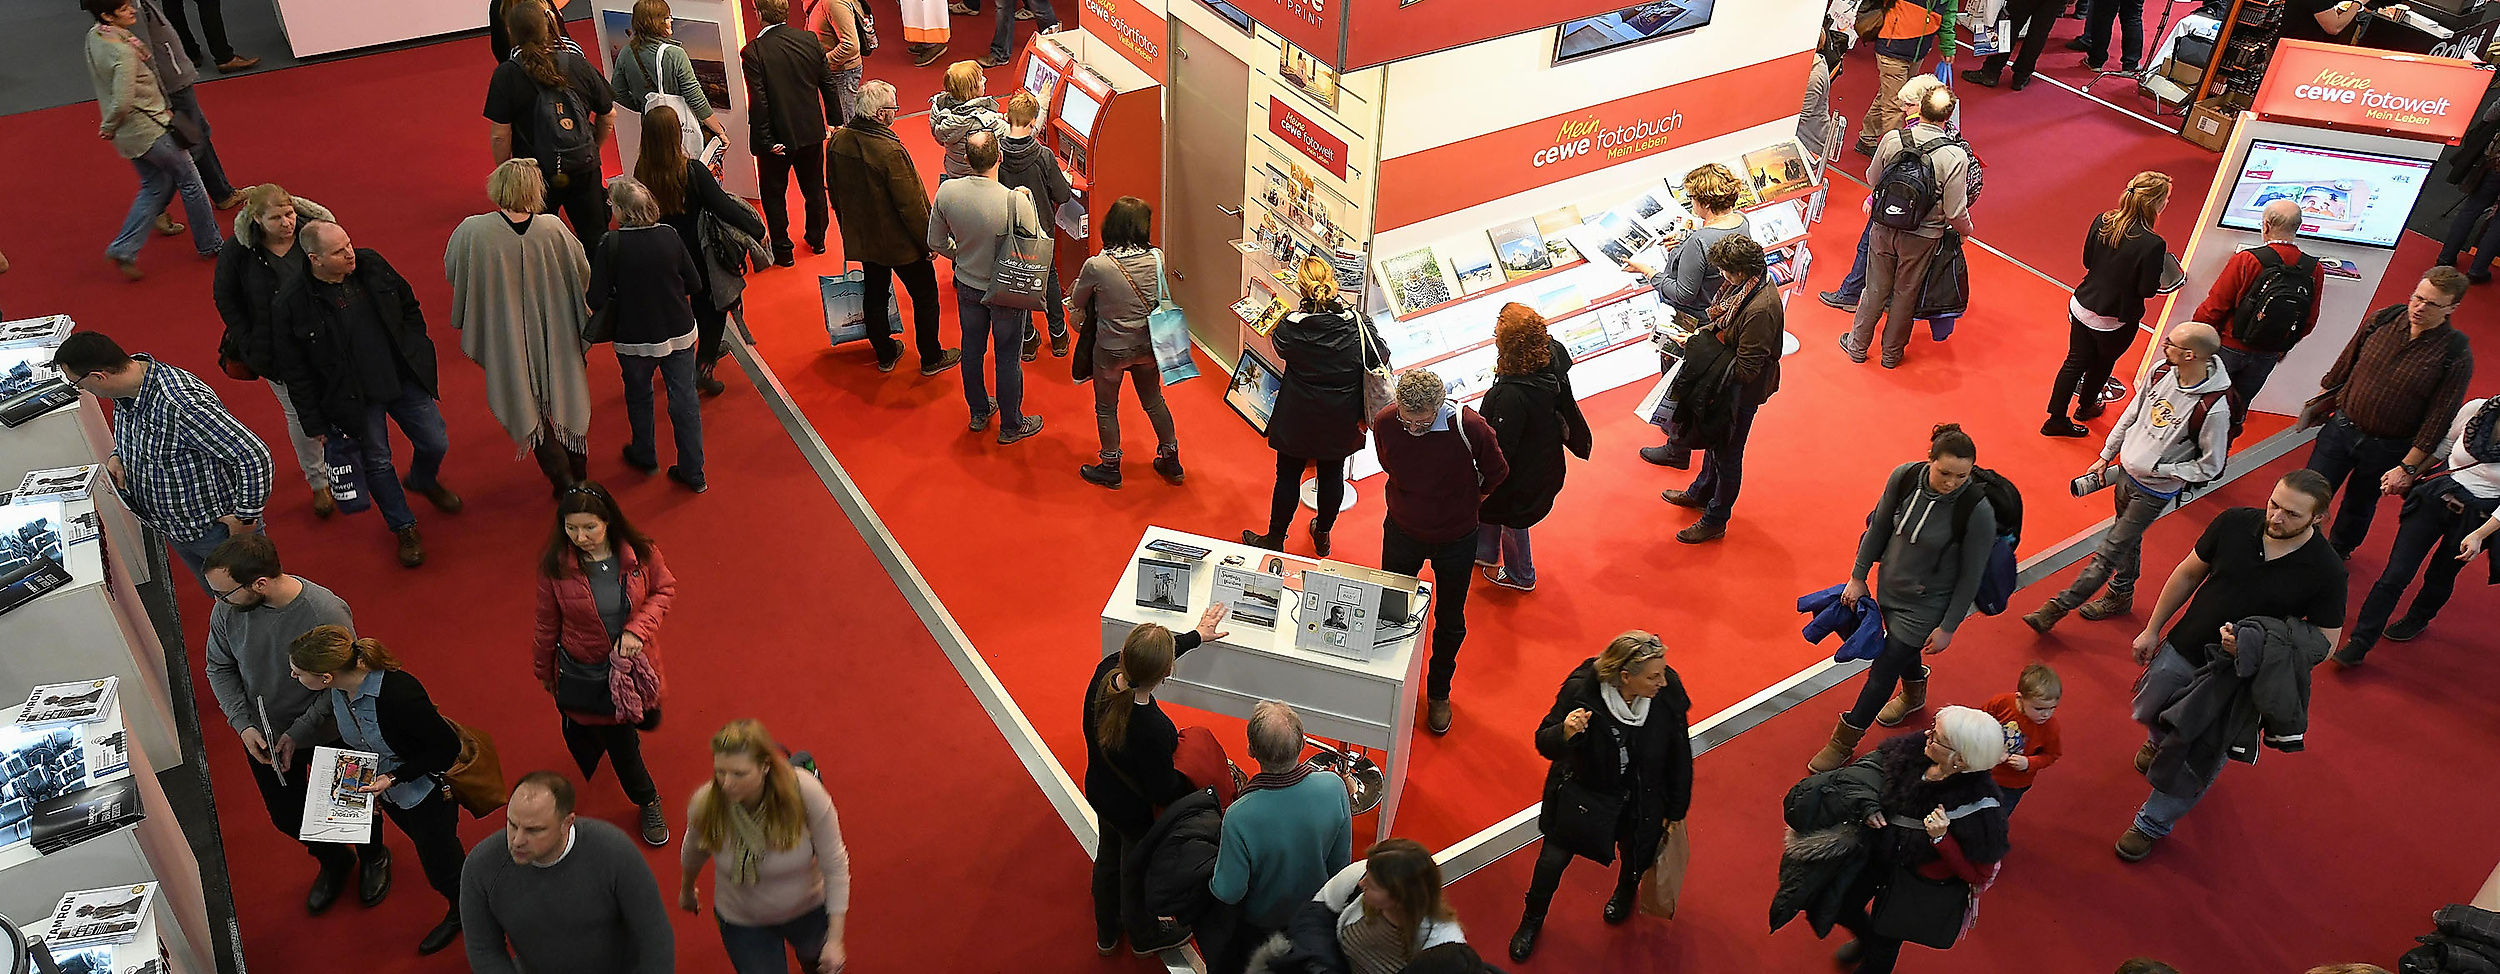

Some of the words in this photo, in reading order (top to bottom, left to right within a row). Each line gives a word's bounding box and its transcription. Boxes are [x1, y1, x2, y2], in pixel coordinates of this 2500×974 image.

[1097, 0, 1116, 13] eine
[1287, 0, 1324, 29] PRINT
[1086, 0, 1109, 22] cewe
[1110, 15, 1158, 57] sofortfotos
[2312, 67, 2371, 90] Meine
[2294, 84, 2356, 104] cewe
[2360, 88, 2450, 116] fotowelt
[1285, 111, 1306, 132] Meine
[1555, 114, 1600, 143] Mein
[2365, 109, 2393, 121] Mein
[2395, 111, 2431, 125] Leben
[1280, 119, 1302, 139] cewe
[1302, 131, 1334, 162] fotowelt
[1532, 137, 1591, 168] cewe
[1595, 109, 1682, 151] fotobuch
[1606, 147, 1633, 160] Mein
[1635, 135, 1668, 153] Leben
[15, 689, 44, 724] TAMRON
[45, 896, 76, 942] TAMRON
